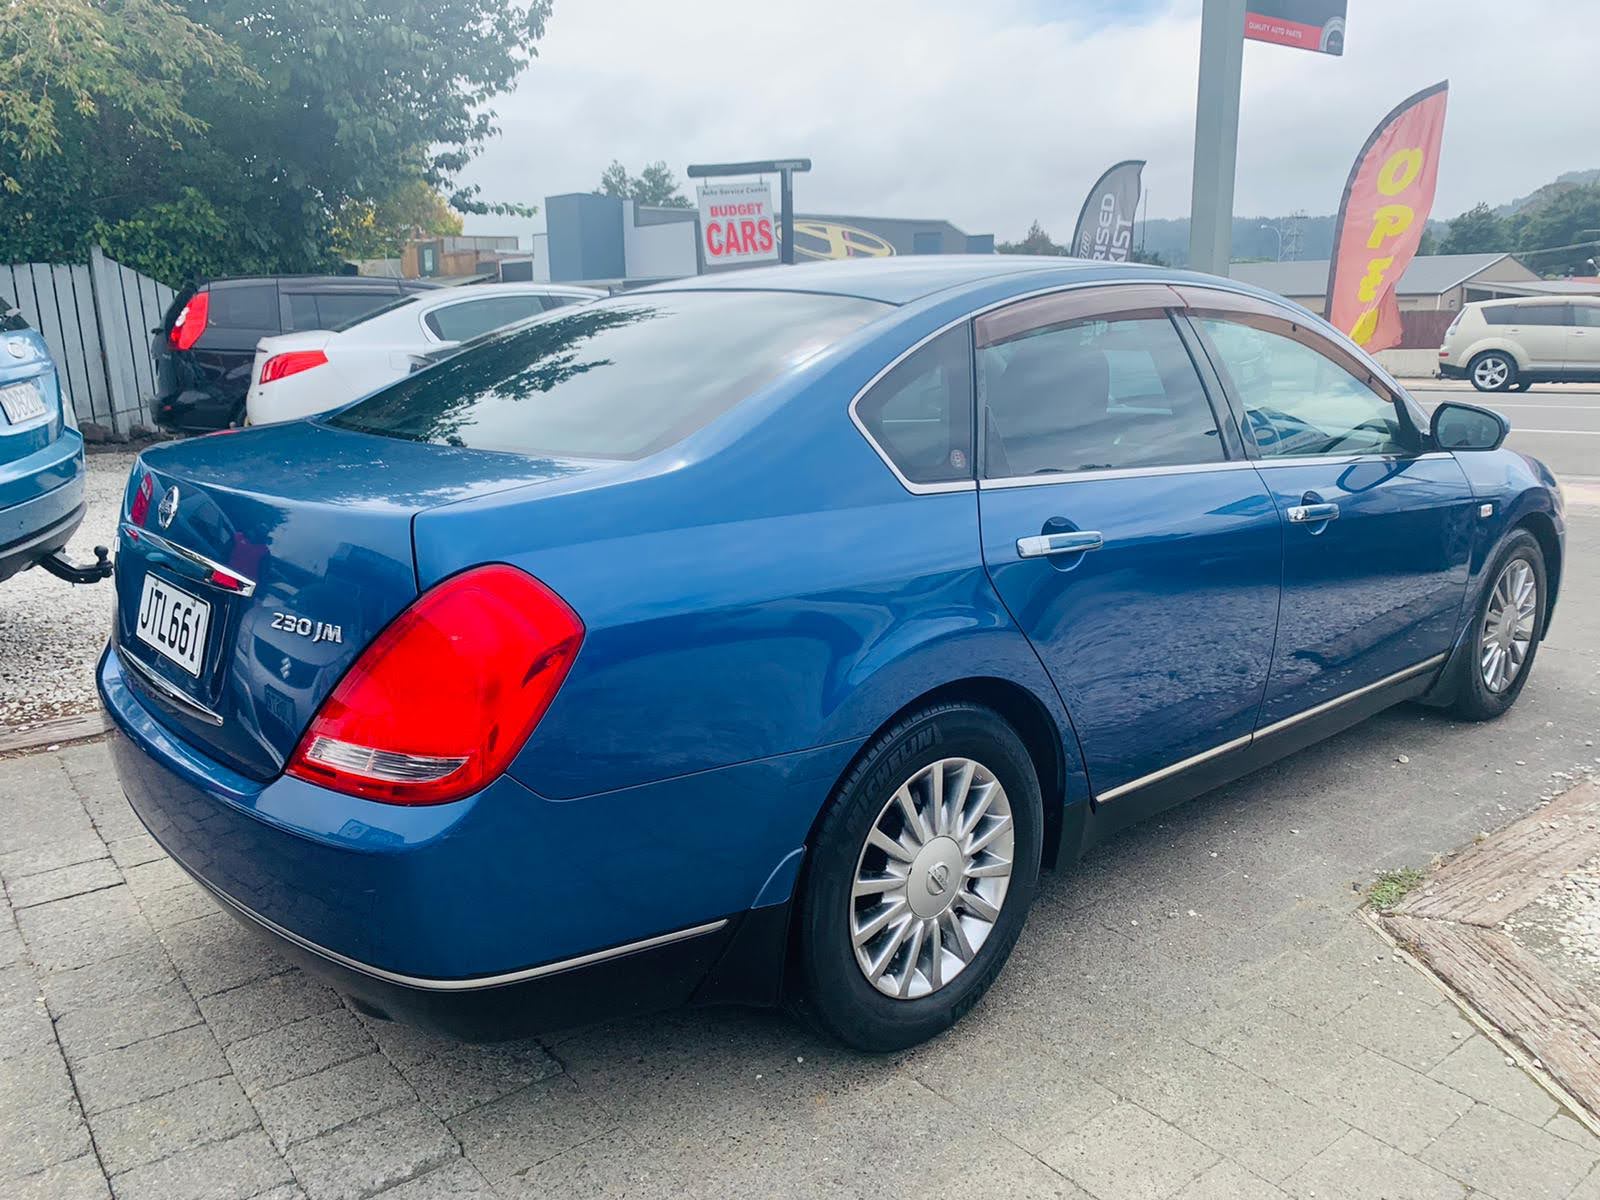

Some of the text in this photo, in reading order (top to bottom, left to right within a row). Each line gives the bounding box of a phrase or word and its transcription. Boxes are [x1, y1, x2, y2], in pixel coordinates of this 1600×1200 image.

[1248, 21, 1302, 39] QUALITY AUTO PARTS
[719, 187, 744, 196] Service
[709, 202, 763, 218] BUDGET
[706, 219, 774, 256] CARS
[140, 586, 201, 663] JTL661
